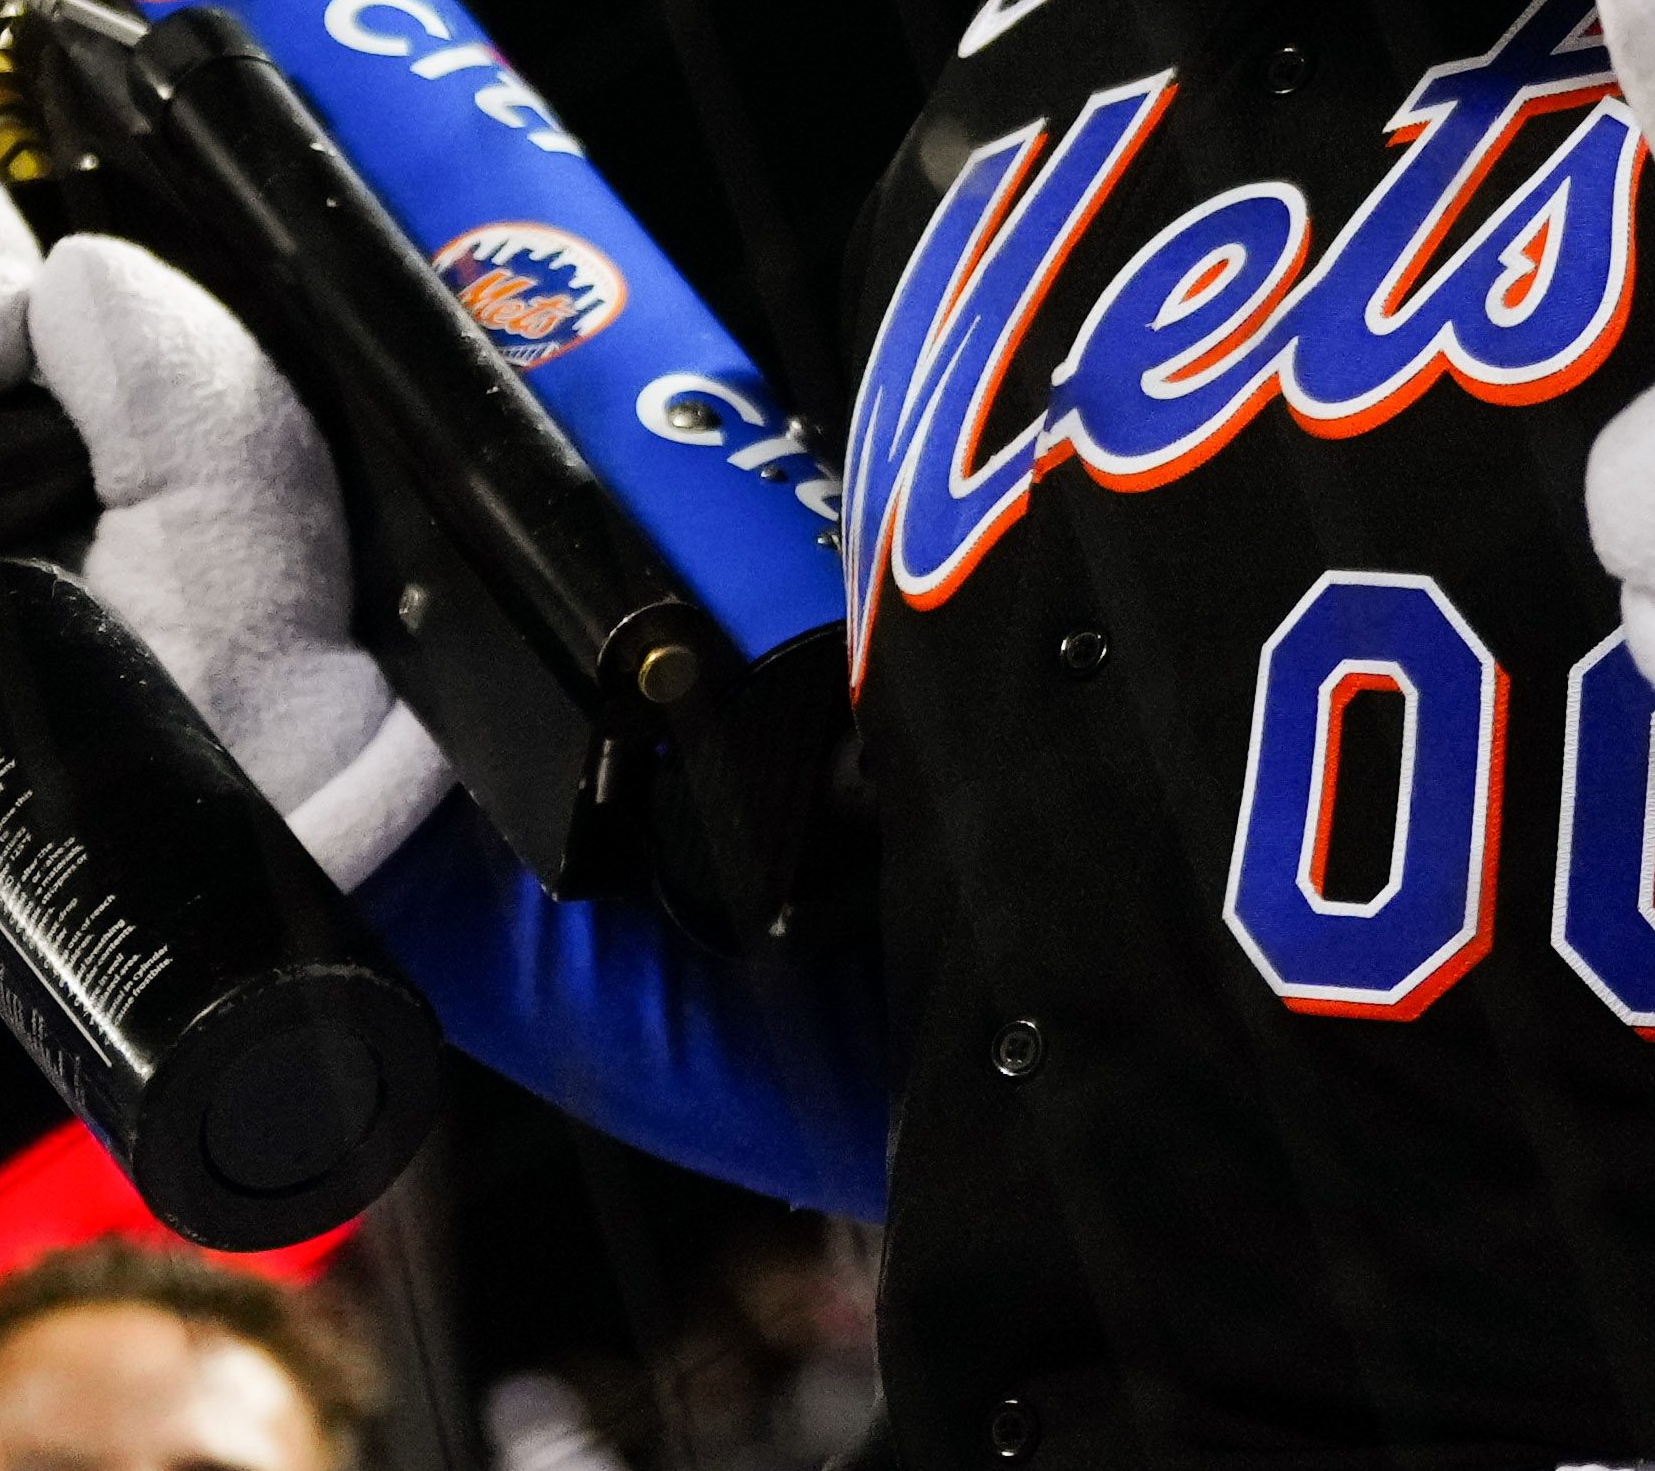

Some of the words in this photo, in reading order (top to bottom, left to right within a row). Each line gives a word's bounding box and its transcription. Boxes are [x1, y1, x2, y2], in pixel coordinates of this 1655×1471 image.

[14, 788, 33, 807] this
[31, 870, 41, 883] or
[63, 836, 75, 847] to
[36, 842, 53, 858] the
[58, 897, 78, 921] drop
[68, 930, 82, 948] out
[80, 916, 90, 930] of
[89, 893, 116, 920] reach
[84, 918, 125, 964] breathing
[97, 924, 136, 965] contents.
[99, 975, 108, 985] in
[106, 952, 124, 974] well
[119, 954, 141, 975] area.
[122, 980, 133, 992] in
[132, 943, 168, 980] cylinder
[132, 957, 173, 997] frostbite.
